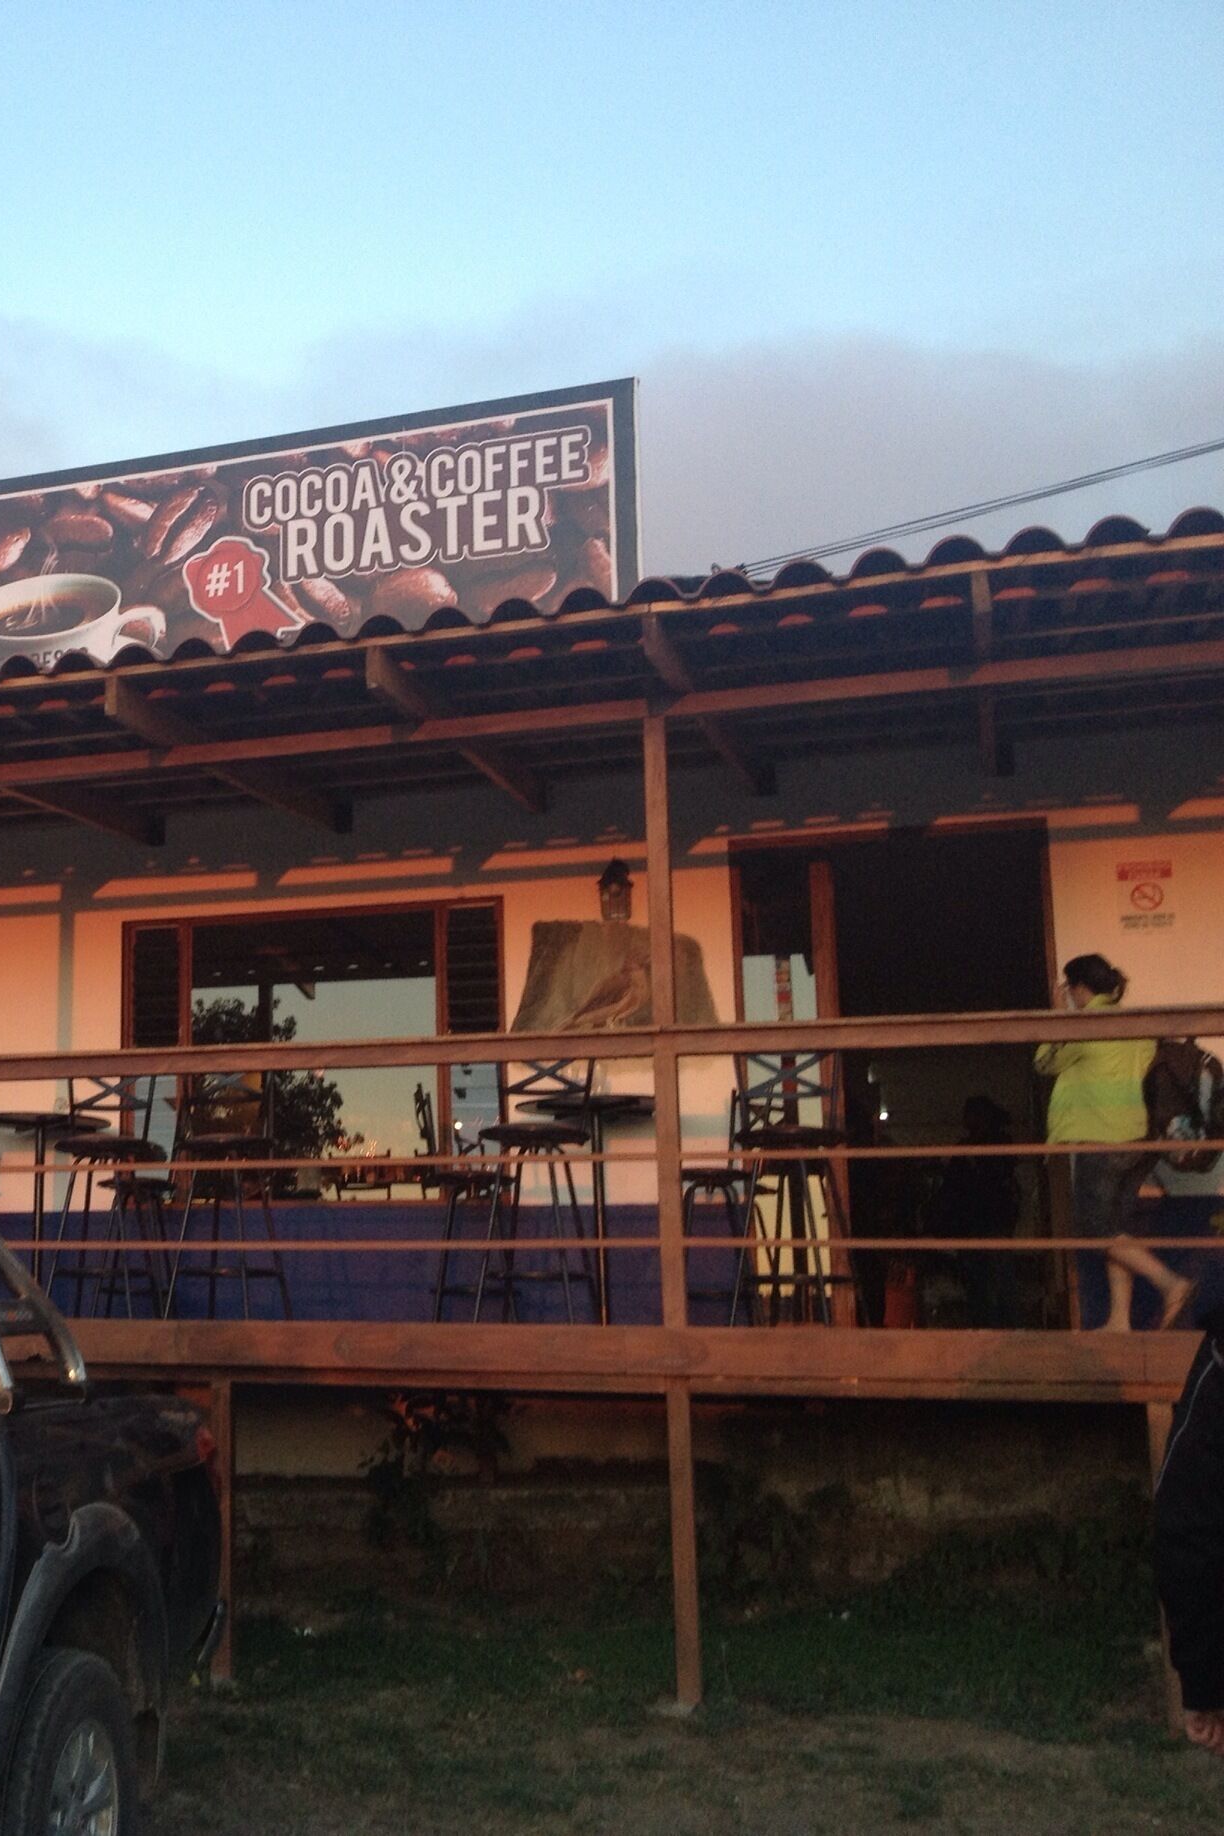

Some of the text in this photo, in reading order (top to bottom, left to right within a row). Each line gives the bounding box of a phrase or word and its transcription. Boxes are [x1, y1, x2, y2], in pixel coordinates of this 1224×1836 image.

[249, 433, 587, 525] COCOA & COFFEE
[284, 487, 545, 578] ROASTER
[205, 560, 244, 598] #1
